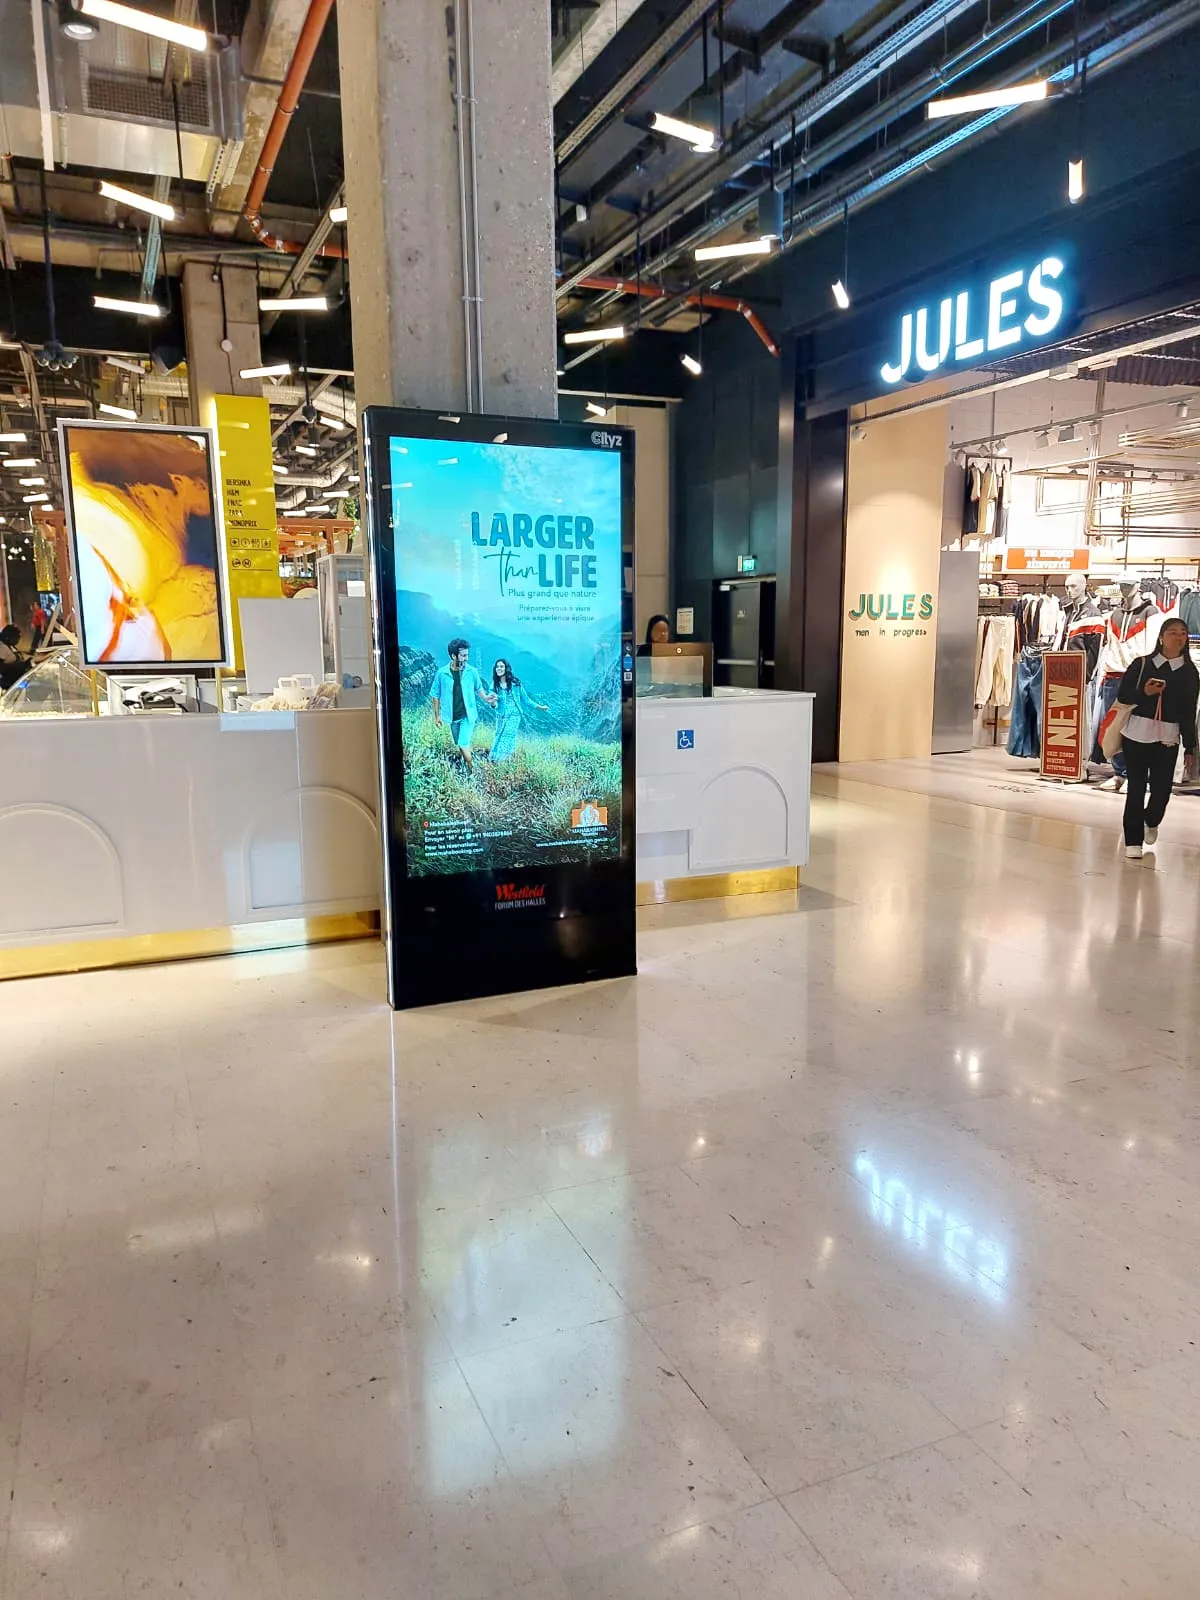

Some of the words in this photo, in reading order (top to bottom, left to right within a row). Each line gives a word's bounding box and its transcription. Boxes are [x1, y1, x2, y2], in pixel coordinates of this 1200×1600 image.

[880, 257, 1064, 383] JULES
[591, 430, 622, 448] Cityz
[471, 511, 595, 550] LARGER
[538, 554, 597, 588] LIFE
[508, 588, 525, 597] Plus
[528, 588, 551, 599] grand
[554, 591, 568, 599] que
[571, 590, 597, 598] nature
[848, 594, 933, 620] JULES
[879, 628, 886, 636] in
[893, 629, 927, 638] progress
[1047, 683, 1078, 747] NEW
[496, 883, 545, 900] Westfield
[495, 900, 514, 910] FORUM
[514, 899, 525, 908] DES
[525, 897, 546, 907] HALLES
